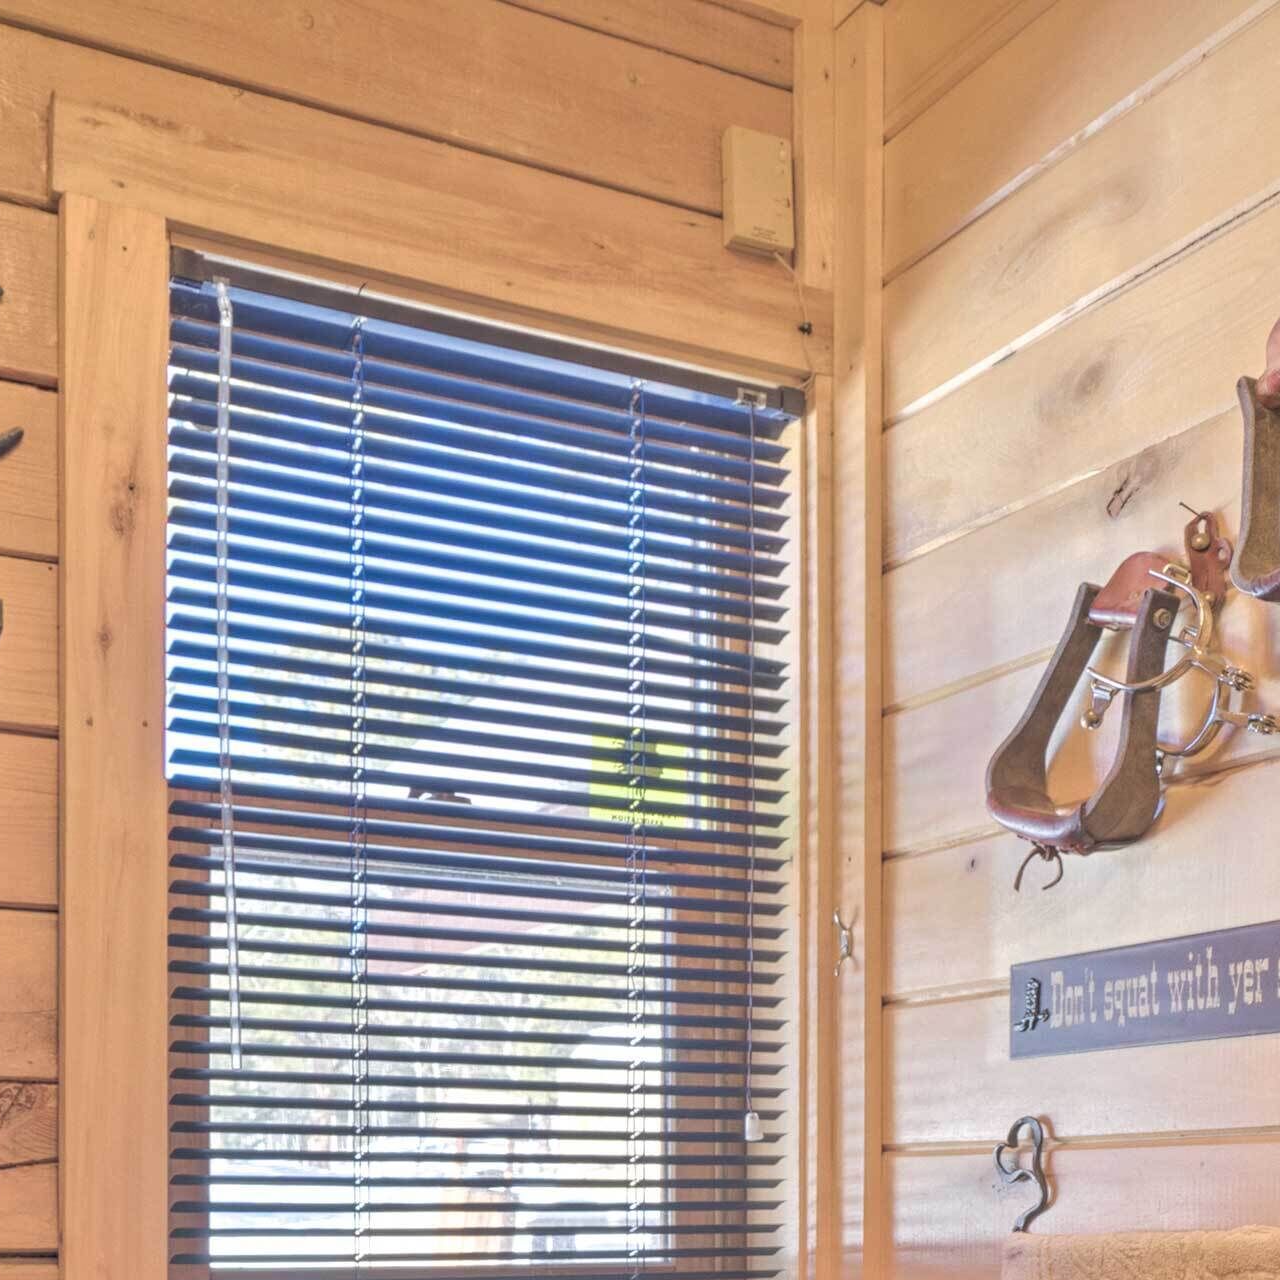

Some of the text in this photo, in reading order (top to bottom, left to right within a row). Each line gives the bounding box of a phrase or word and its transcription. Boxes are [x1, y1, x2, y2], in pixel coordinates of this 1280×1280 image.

[1050, 968, 1097, 1028] Don't
[1103, 960, 1160, 1027] squat
[1168, 946, 1220, 1013] with
[1228, 957, 1269, 1015] yer
